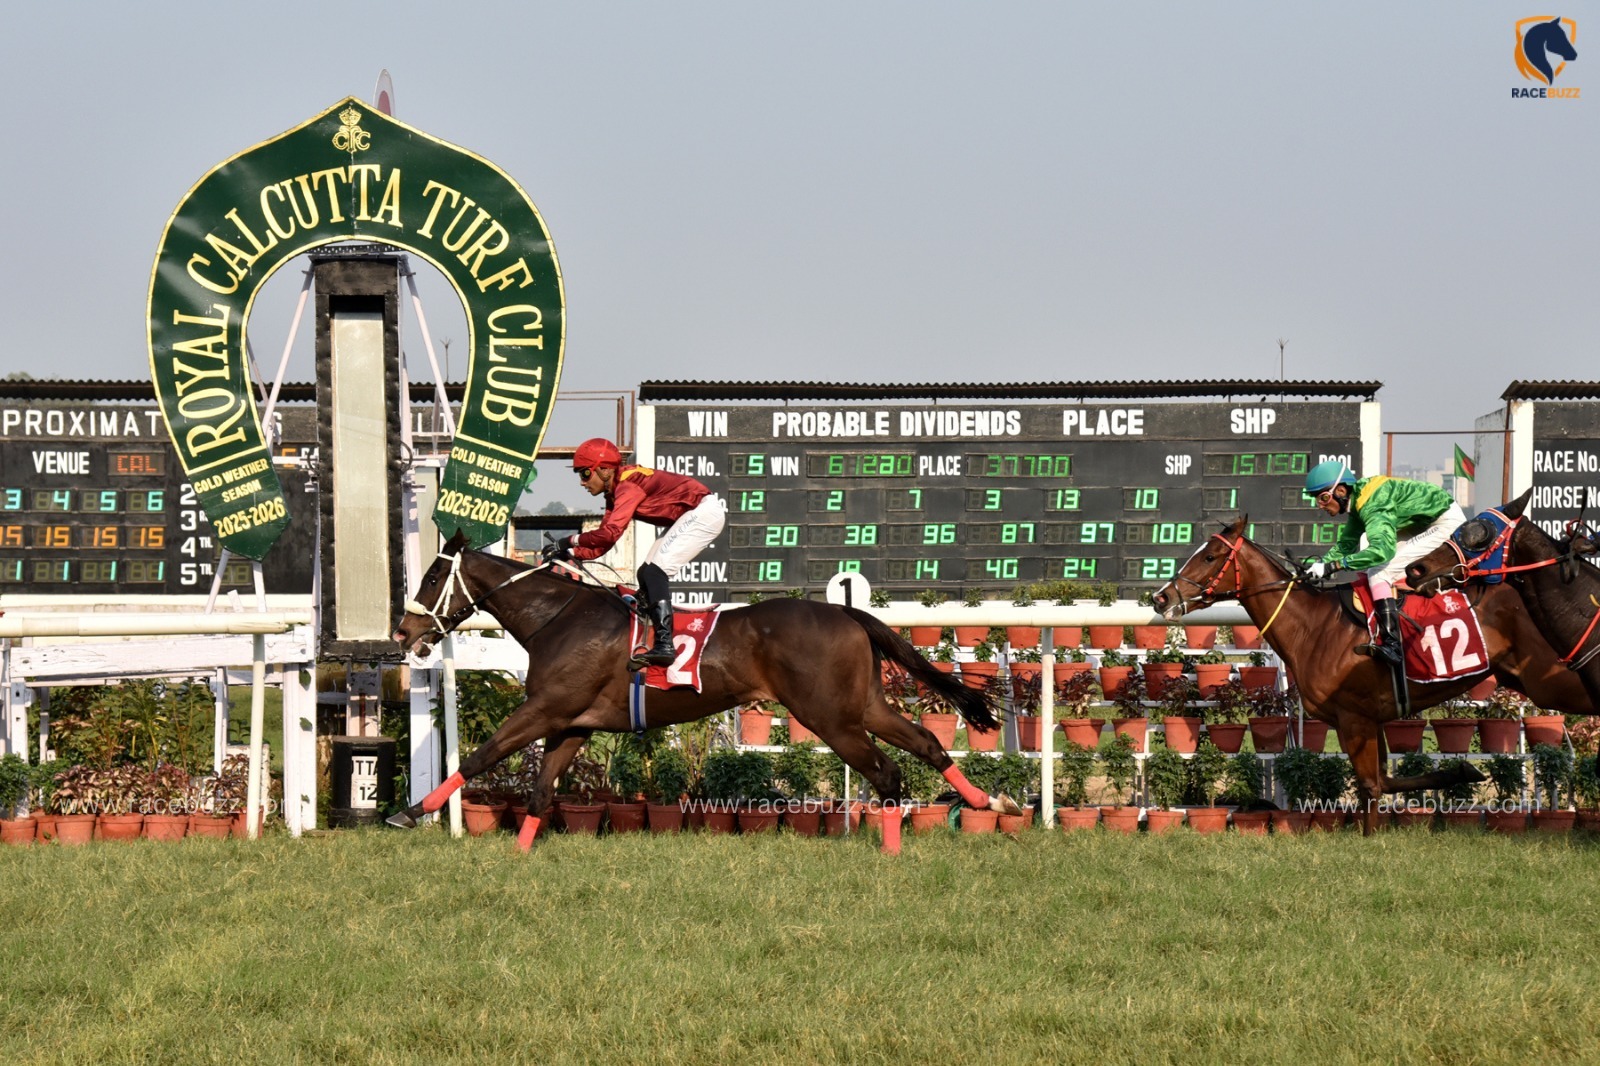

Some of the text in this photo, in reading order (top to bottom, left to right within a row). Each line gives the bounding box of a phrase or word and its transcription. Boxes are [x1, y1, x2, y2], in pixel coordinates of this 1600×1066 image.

[173, 164, 544, 457] ROYAL CALCUTTA TURF CLUB
[688, 408, 1276, 437] WIN PROBABLE DIVIDENDS PLACE SHP
[32, 451, 90, 474] VENUE
[117, 455, 157, 473] CAL
[451, 446, 523, 479] COLD WEATHER
[657, 456, 720, 476] RACE No.
[748, 455, 764, 475] 5
[771, 456, 799, 476] WIN
[919, 456, 961, 476] PLACE
[1165, 455, 1192, 475] SHP
[1534, 451, 1574, 472] RACE
[194, 458, 269, 494] COLD WEATHER
[467, 472, 510, 496] SEASON
[5, 490, 163, 511] 3 4 5 6
[221, 479, 262, 503] SEASON
[740, 491, 764, 511] 12
[827, 491, 843, 511] 2
[909, 490, 921, 509] 7
[985, 490, 1001, 510] 3
[1056, 489, 1080, 510] 13
[1135, 489, 1158, 510] 10
[1230, 488, 1237, 509] 1
[1533, 486, 1582, 508] HORSE
[213, 496, 286, 538] 2025-2026
[437, 488, 510, 527] 2025-2026
[45, 527, 70, 546] 15
[93, 527, 117, 546] 15
[140, 527, 163, 546] 15
[765, 526, 799, 546] 20
[844, 526, 877, 545] 38
[923, 525, 956, 544] 96
[1002, 524, 1035, 543] 87
[1081, 523, 1114, 543] 97
[1152, 523, 1192, 543] 108
[701, 562, 728, 582] DIV.
[758, 562, 782, 581] 18
[916, 560, 939, 579] 14
[986, 559, 1018, 579] 40
[1064, 558, 1096, 578] 24
[1143, 558, 1176, 578] 23
[838, 577, 852, 607] 1
[1420, 618, 1481, 676] 12
[666, 634, 697, 685] 2
